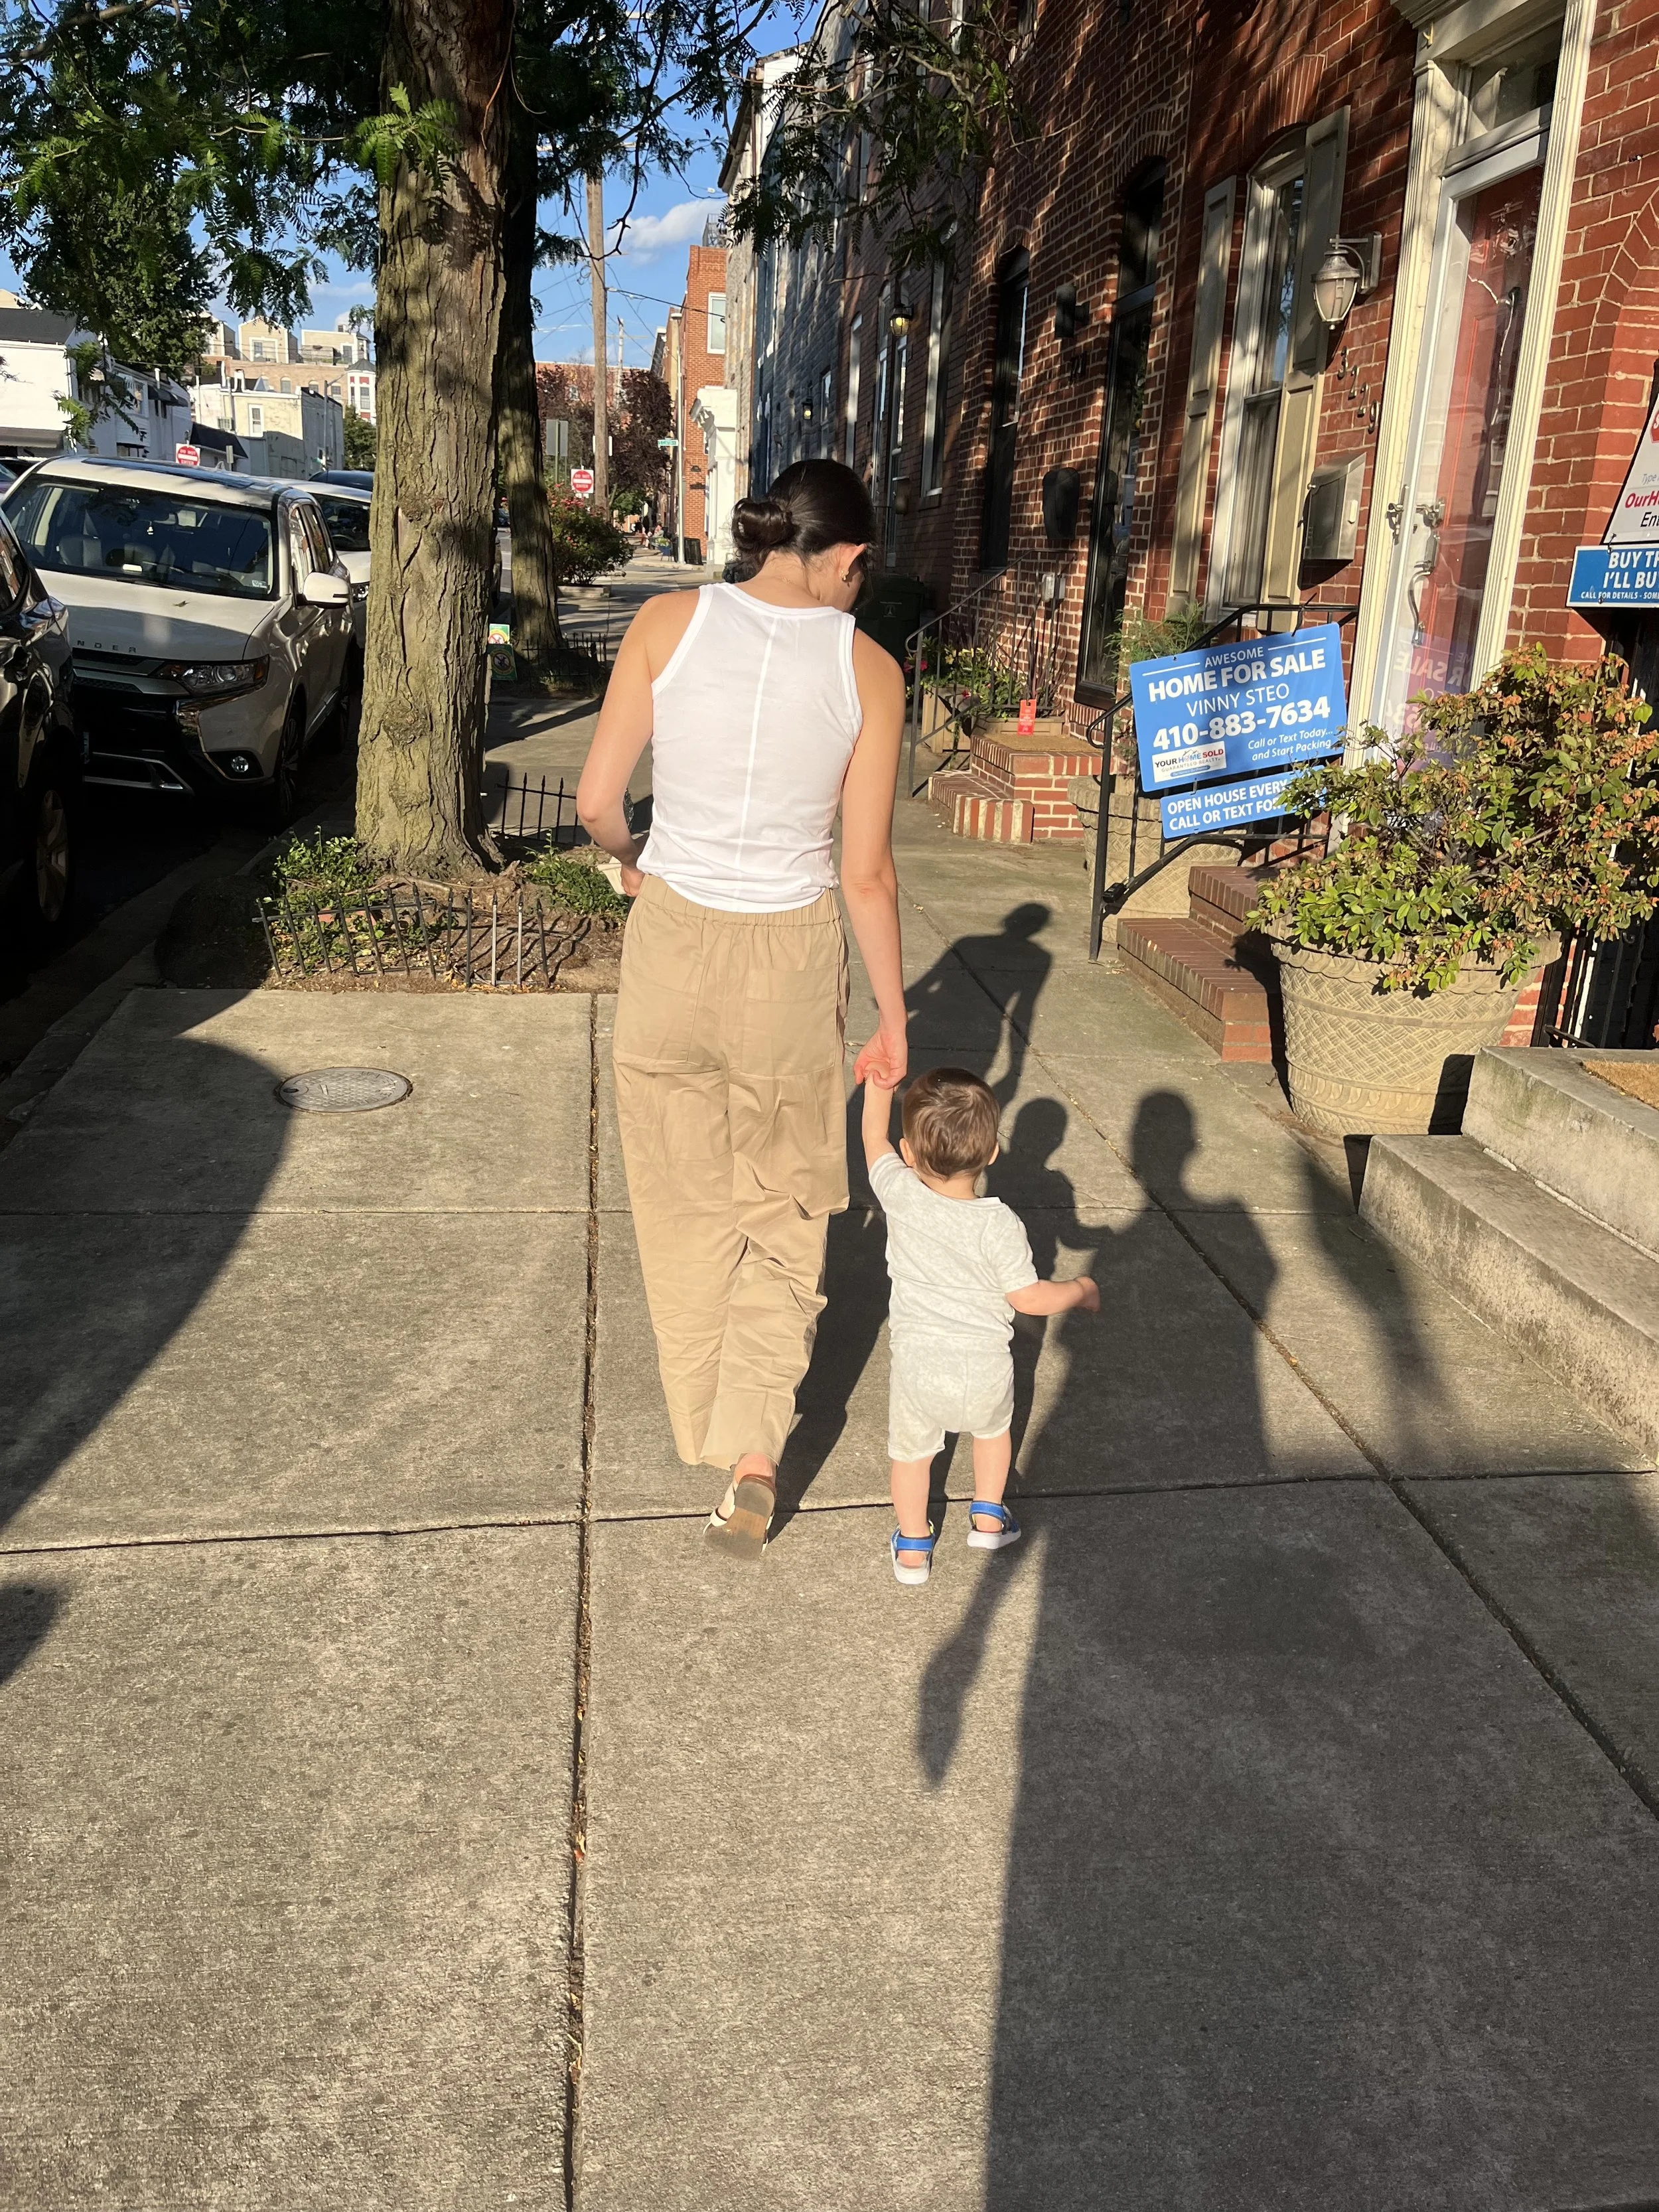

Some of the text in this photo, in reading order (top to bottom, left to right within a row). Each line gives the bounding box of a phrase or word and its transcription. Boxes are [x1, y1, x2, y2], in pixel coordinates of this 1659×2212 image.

[1337, 346, 1380, 435] 3229
[1642, 473, 1656, 485] Type
[1625, 490, 1659, 508] OurH
[1608, 552, 1642, 569] BUY
[1603, 571, 1659, 589] I'LL BU
[1204, 646, 1263, 668] AWESOME
[1149, 648, 1326, 702] HOME FOR SALE
[1187, 683, 1289, 717] VINNY STEO
[1153, 696, 1331, 751] 410-883-7634
[1248, 738, 1265, 749] Call
[1267, 737, 1277, 746] or
[1279, 733, 1297, 743] Text
[1252, 739, 1331, 761] and Start Packing
[1155, 758, 1177, 769] YOUR
[1202, 749, 1224, 759] SOLD
[1167, 796, 1202, 815] OPEN
[1204, 787, 1247, 808] HOUSE
[1169, 813, 1200, 831] CALL
[1202, 810, 1220, 824] OR
[1222, 803, 1253, 820] TEXT
